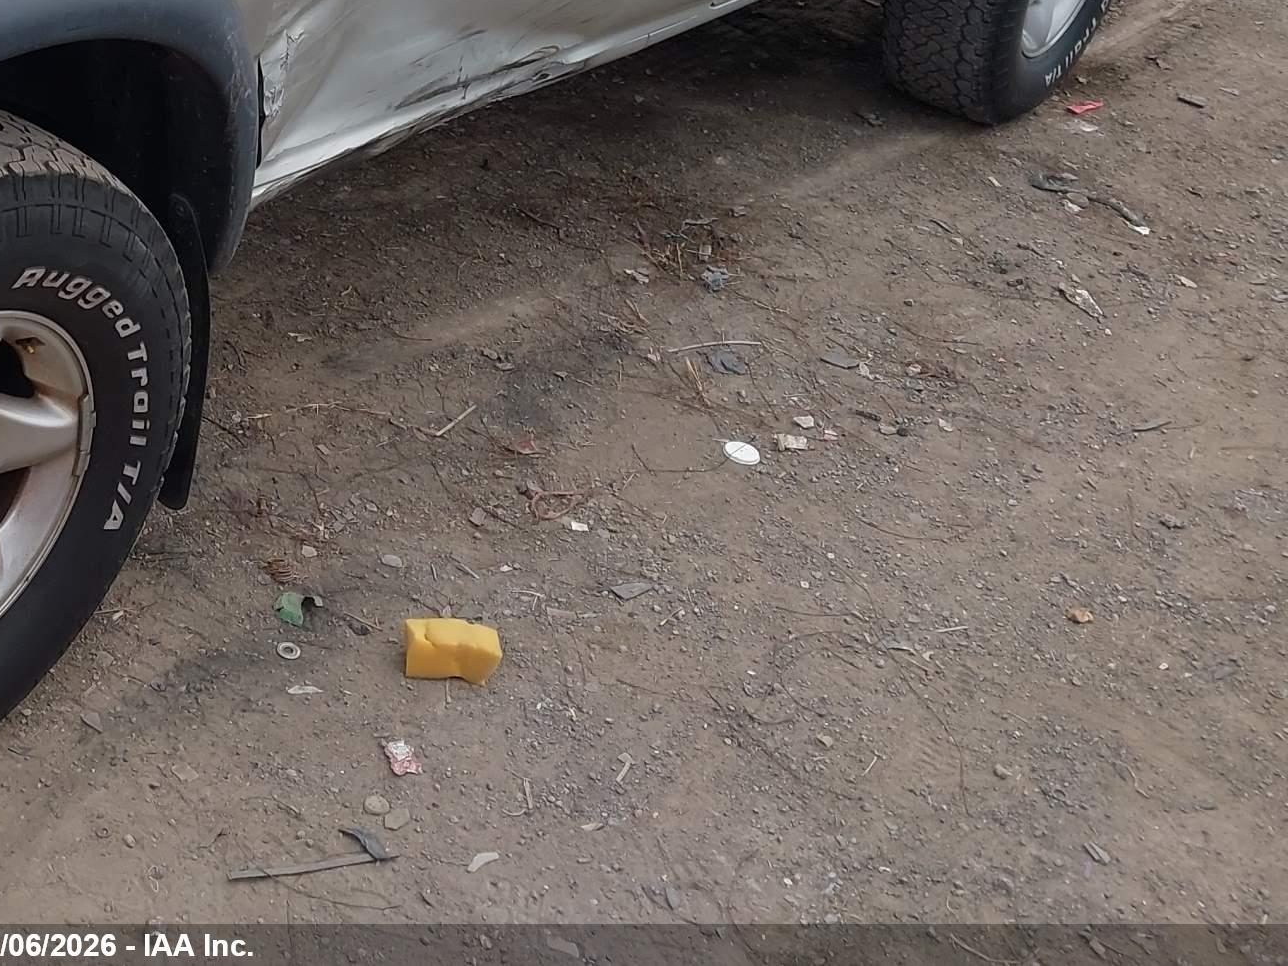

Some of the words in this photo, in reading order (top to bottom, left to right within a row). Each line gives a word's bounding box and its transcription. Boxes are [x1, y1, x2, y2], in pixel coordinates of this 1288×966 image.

[12, 266, 142, 338] Rugged
[127, 341, 151, 446] Trail
[103, 460, 142, 530] T/A
